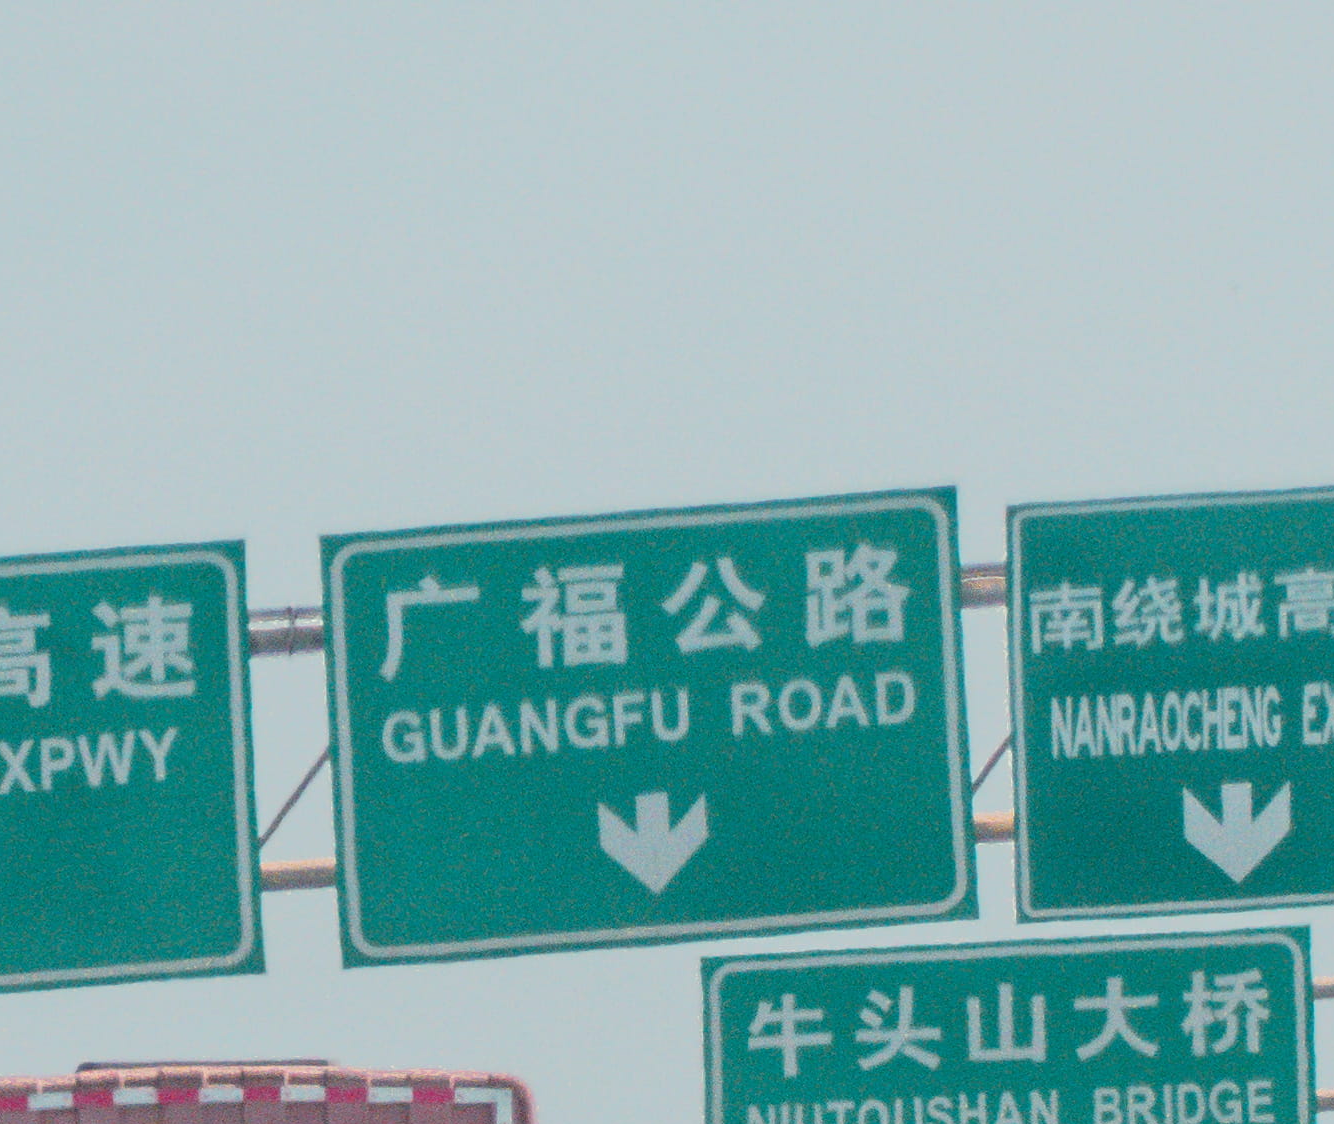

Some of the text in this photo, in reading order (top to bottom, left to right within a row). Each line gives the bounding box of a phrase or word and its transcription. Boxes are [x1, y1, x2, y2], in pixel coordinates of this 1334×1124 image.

[380, 542, 911, 681] 广福公路
[382, 670, 917, 763] GUANGFU ROAD
[1051, 686, 1283, 758] NANRAOCHENG
[747, 968, 1271, 1079] 牛头山大桥
